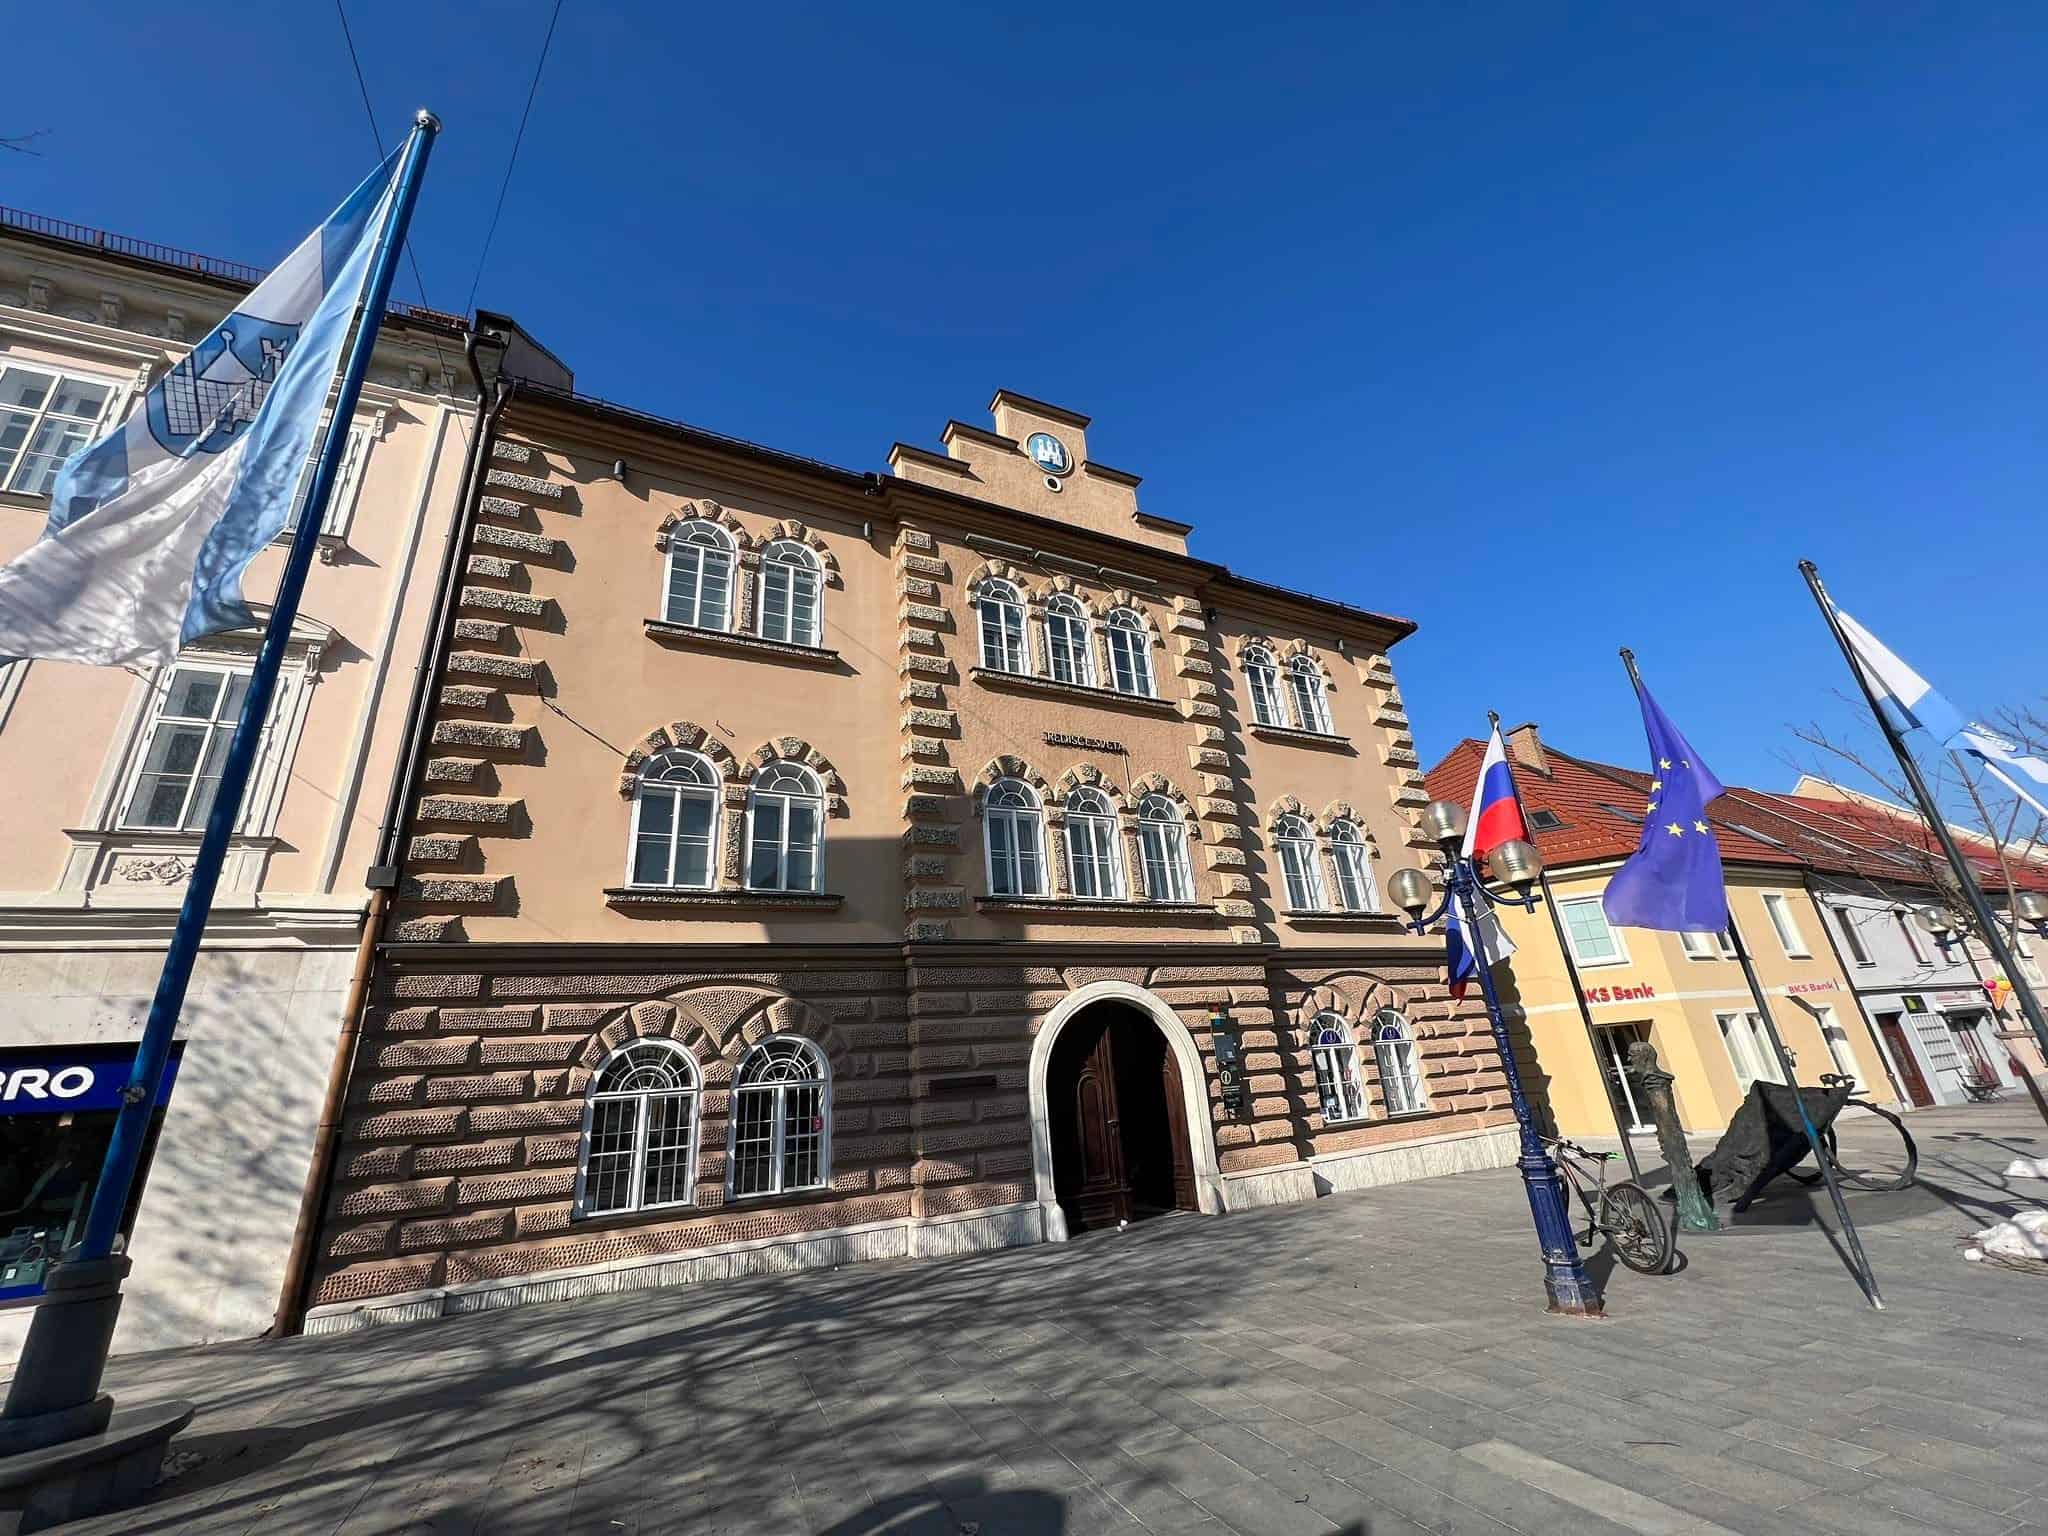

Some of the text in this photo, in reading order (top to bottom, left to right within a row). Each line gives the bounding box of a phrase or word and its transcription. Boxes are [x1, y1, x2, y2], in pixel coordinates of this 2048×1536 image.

[1584, 982, 1655, 1003] KS Bank
[1788, 984, 1809, 993] BKS
[0, 1066, 95, 1101] RO
